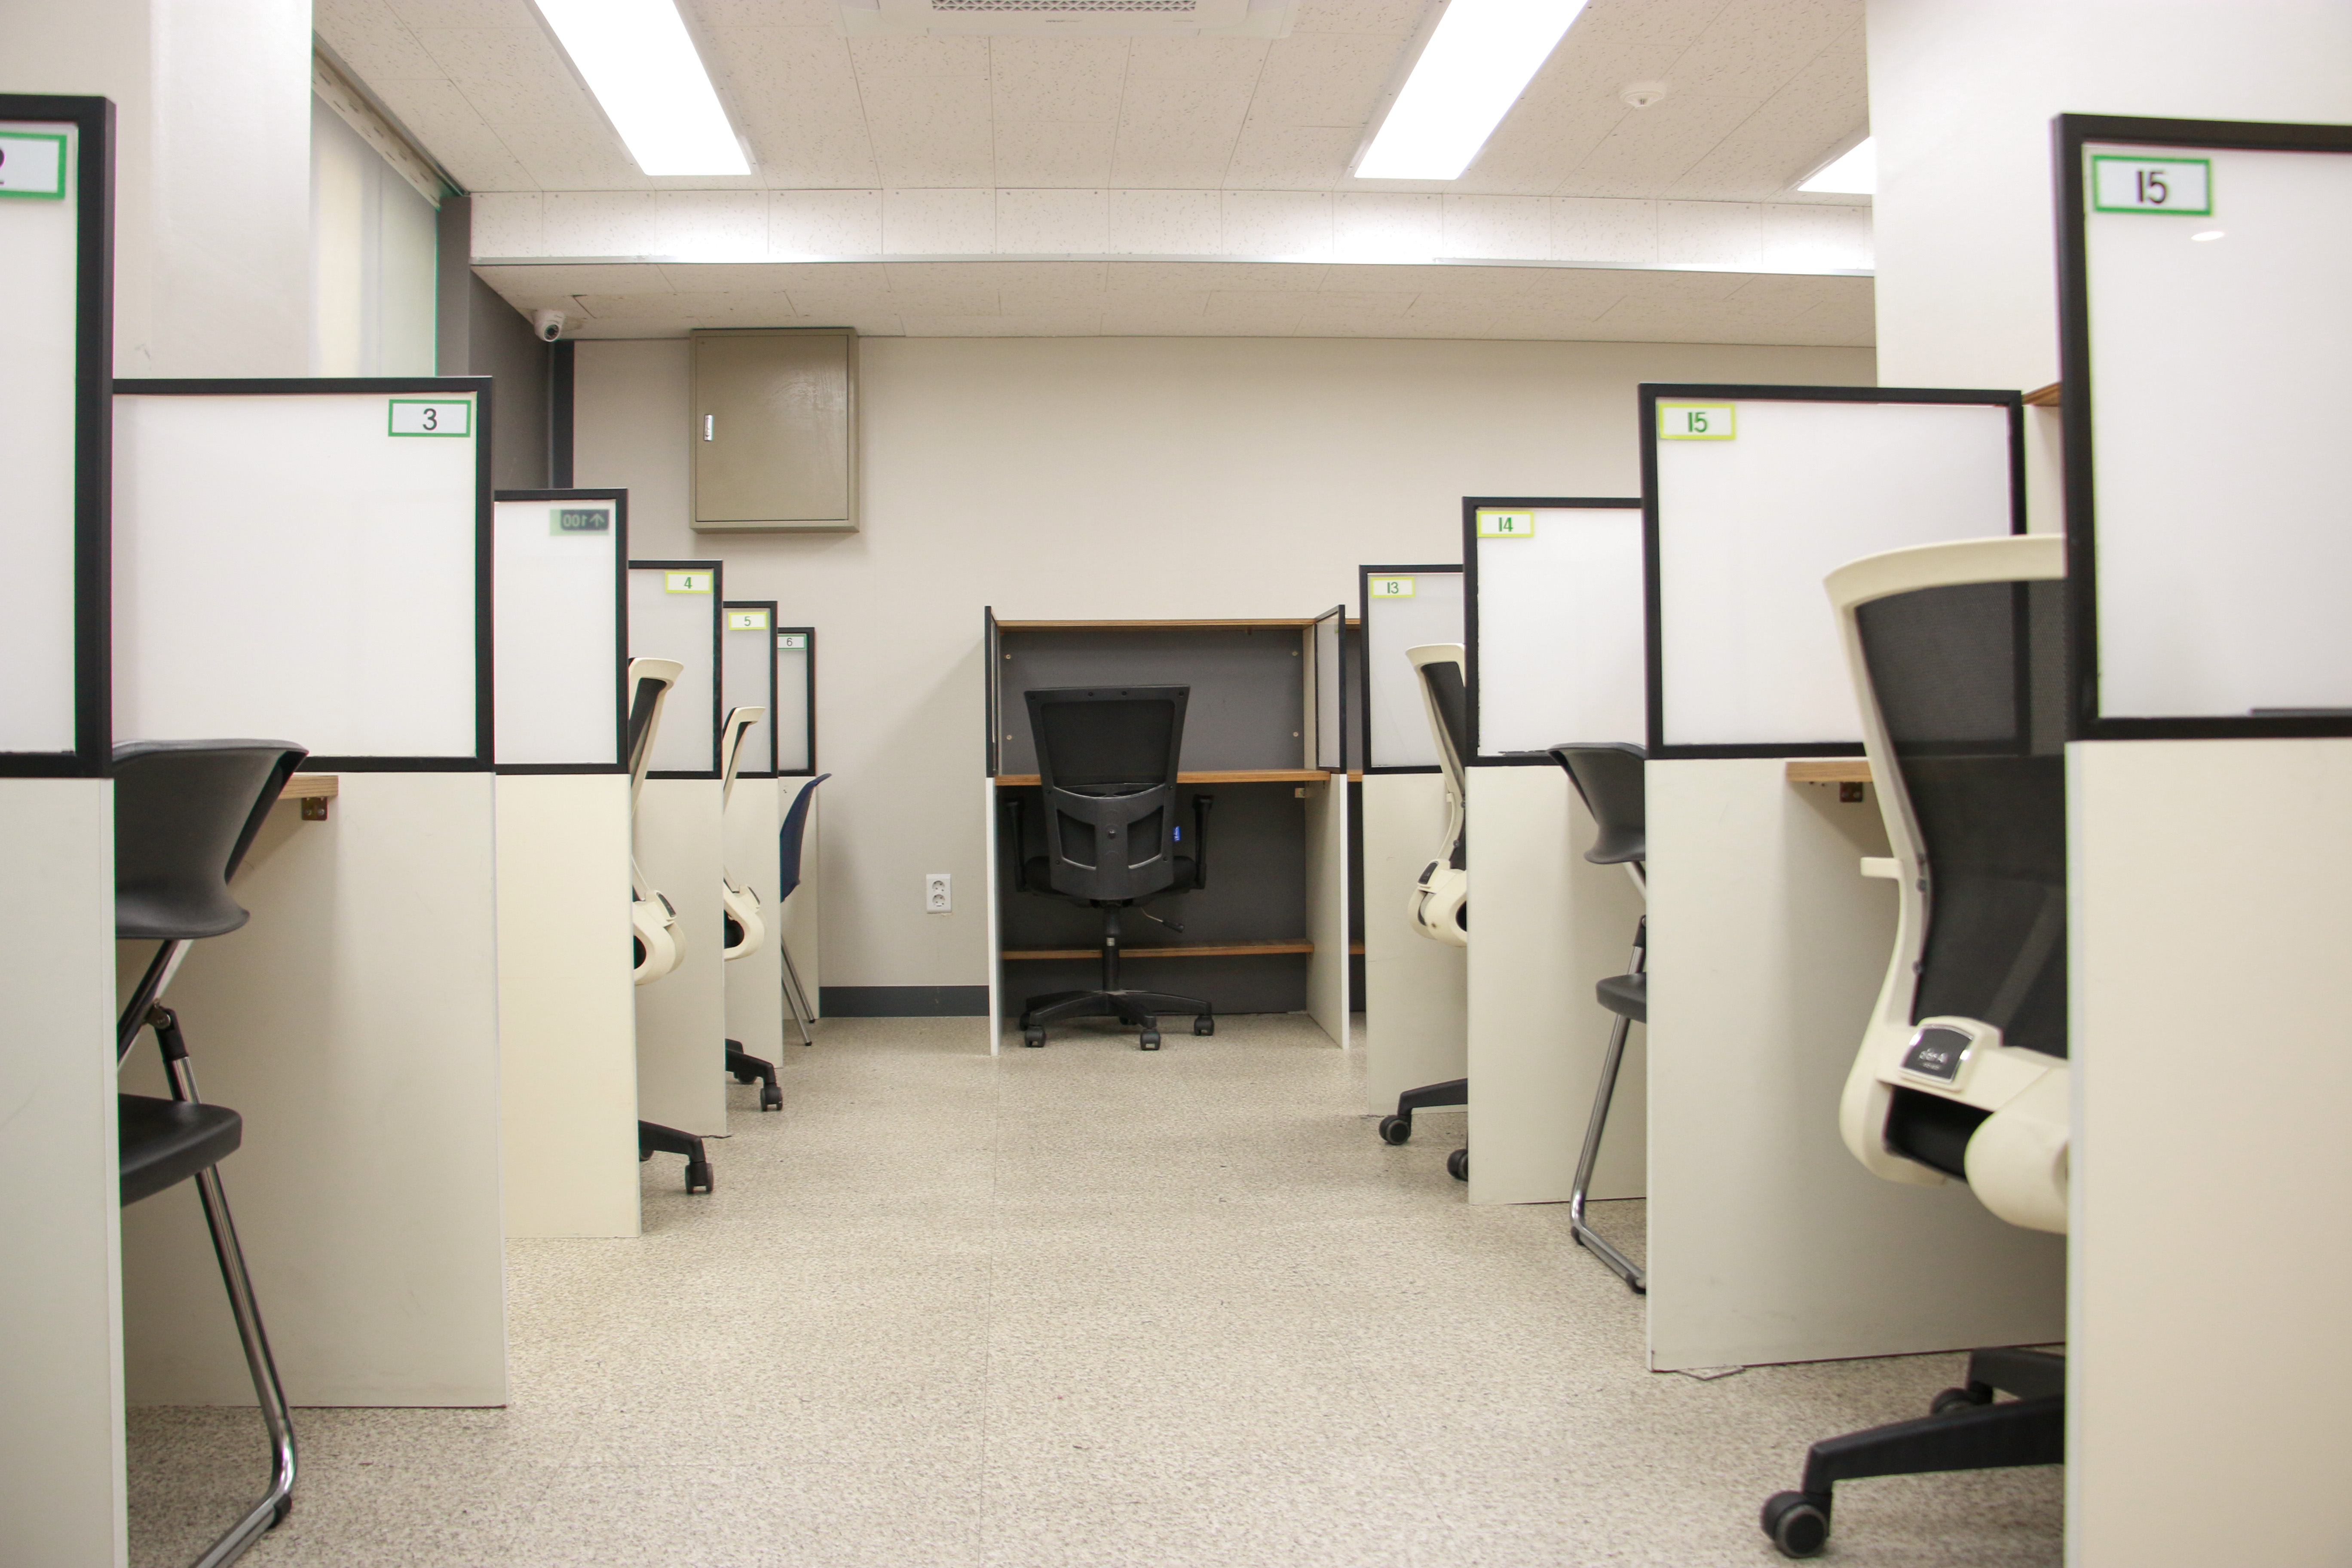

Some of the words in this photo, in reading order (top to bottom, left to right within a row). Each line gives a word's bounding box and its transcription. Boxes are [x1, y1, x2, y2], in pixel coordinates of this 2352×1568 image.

[2138, 170, 2168, 205] 15
[422, 408, 438, 431] 3
[1687, 412, 1708, 433] 15
[1499, 517, 1513, 532] 14
[684, 576, 692, 589] 4
[1387, 582, 1399, 594] 13
[744, 616, 751, 627] 5
[786, 637, 793, 647] 6
